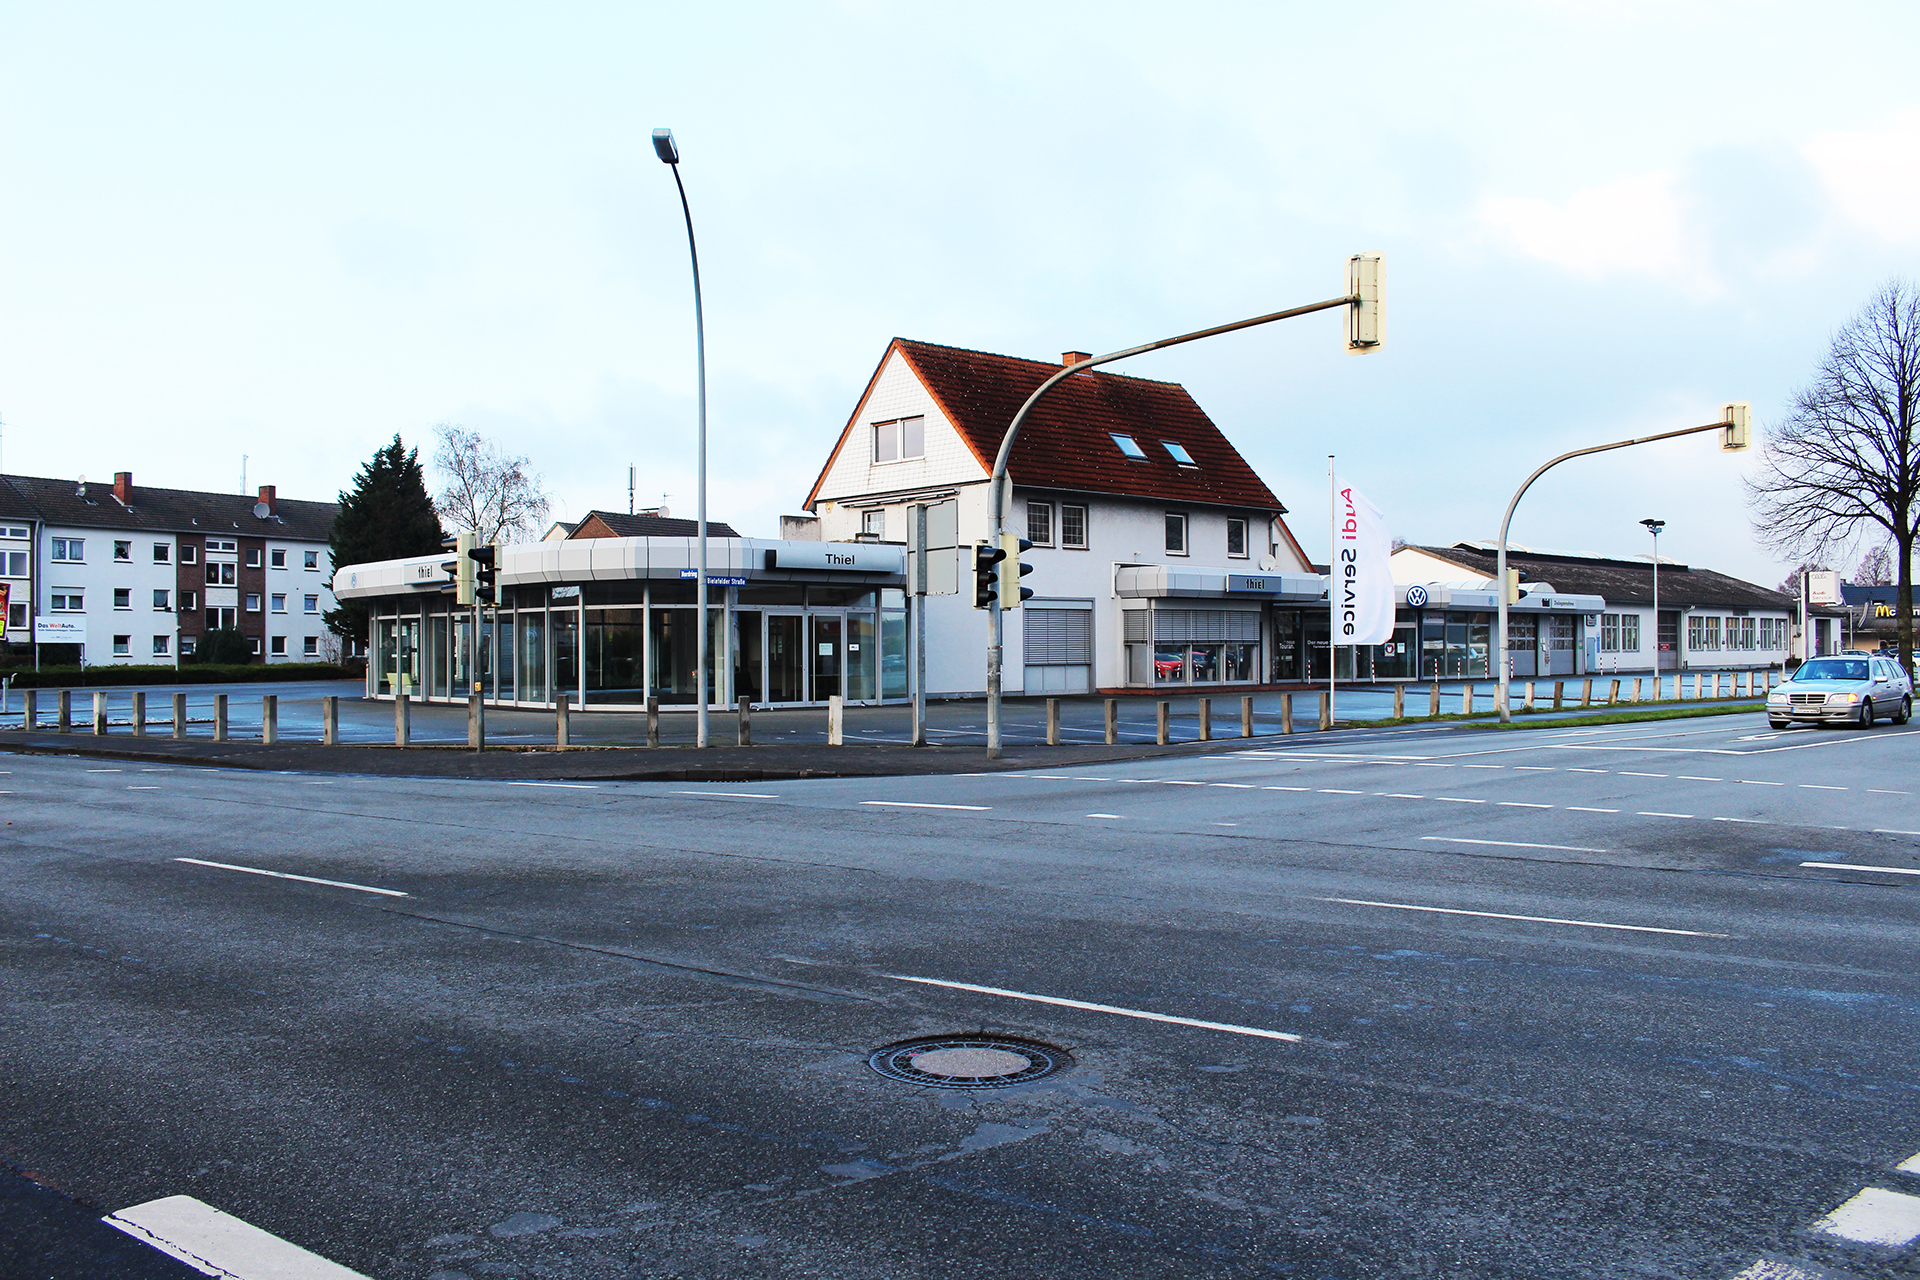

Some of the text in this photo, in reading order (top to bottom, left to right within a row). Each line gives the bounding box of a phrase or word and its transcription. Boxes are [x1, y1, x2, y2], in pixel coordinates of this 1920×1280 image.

[825, 553, 855, 565] Thiel
[418, 565, 433, 578] thiel
[707, 577, 746, 586] Bielefelder Straße
[1245, 578, 1265, 590] thiel
